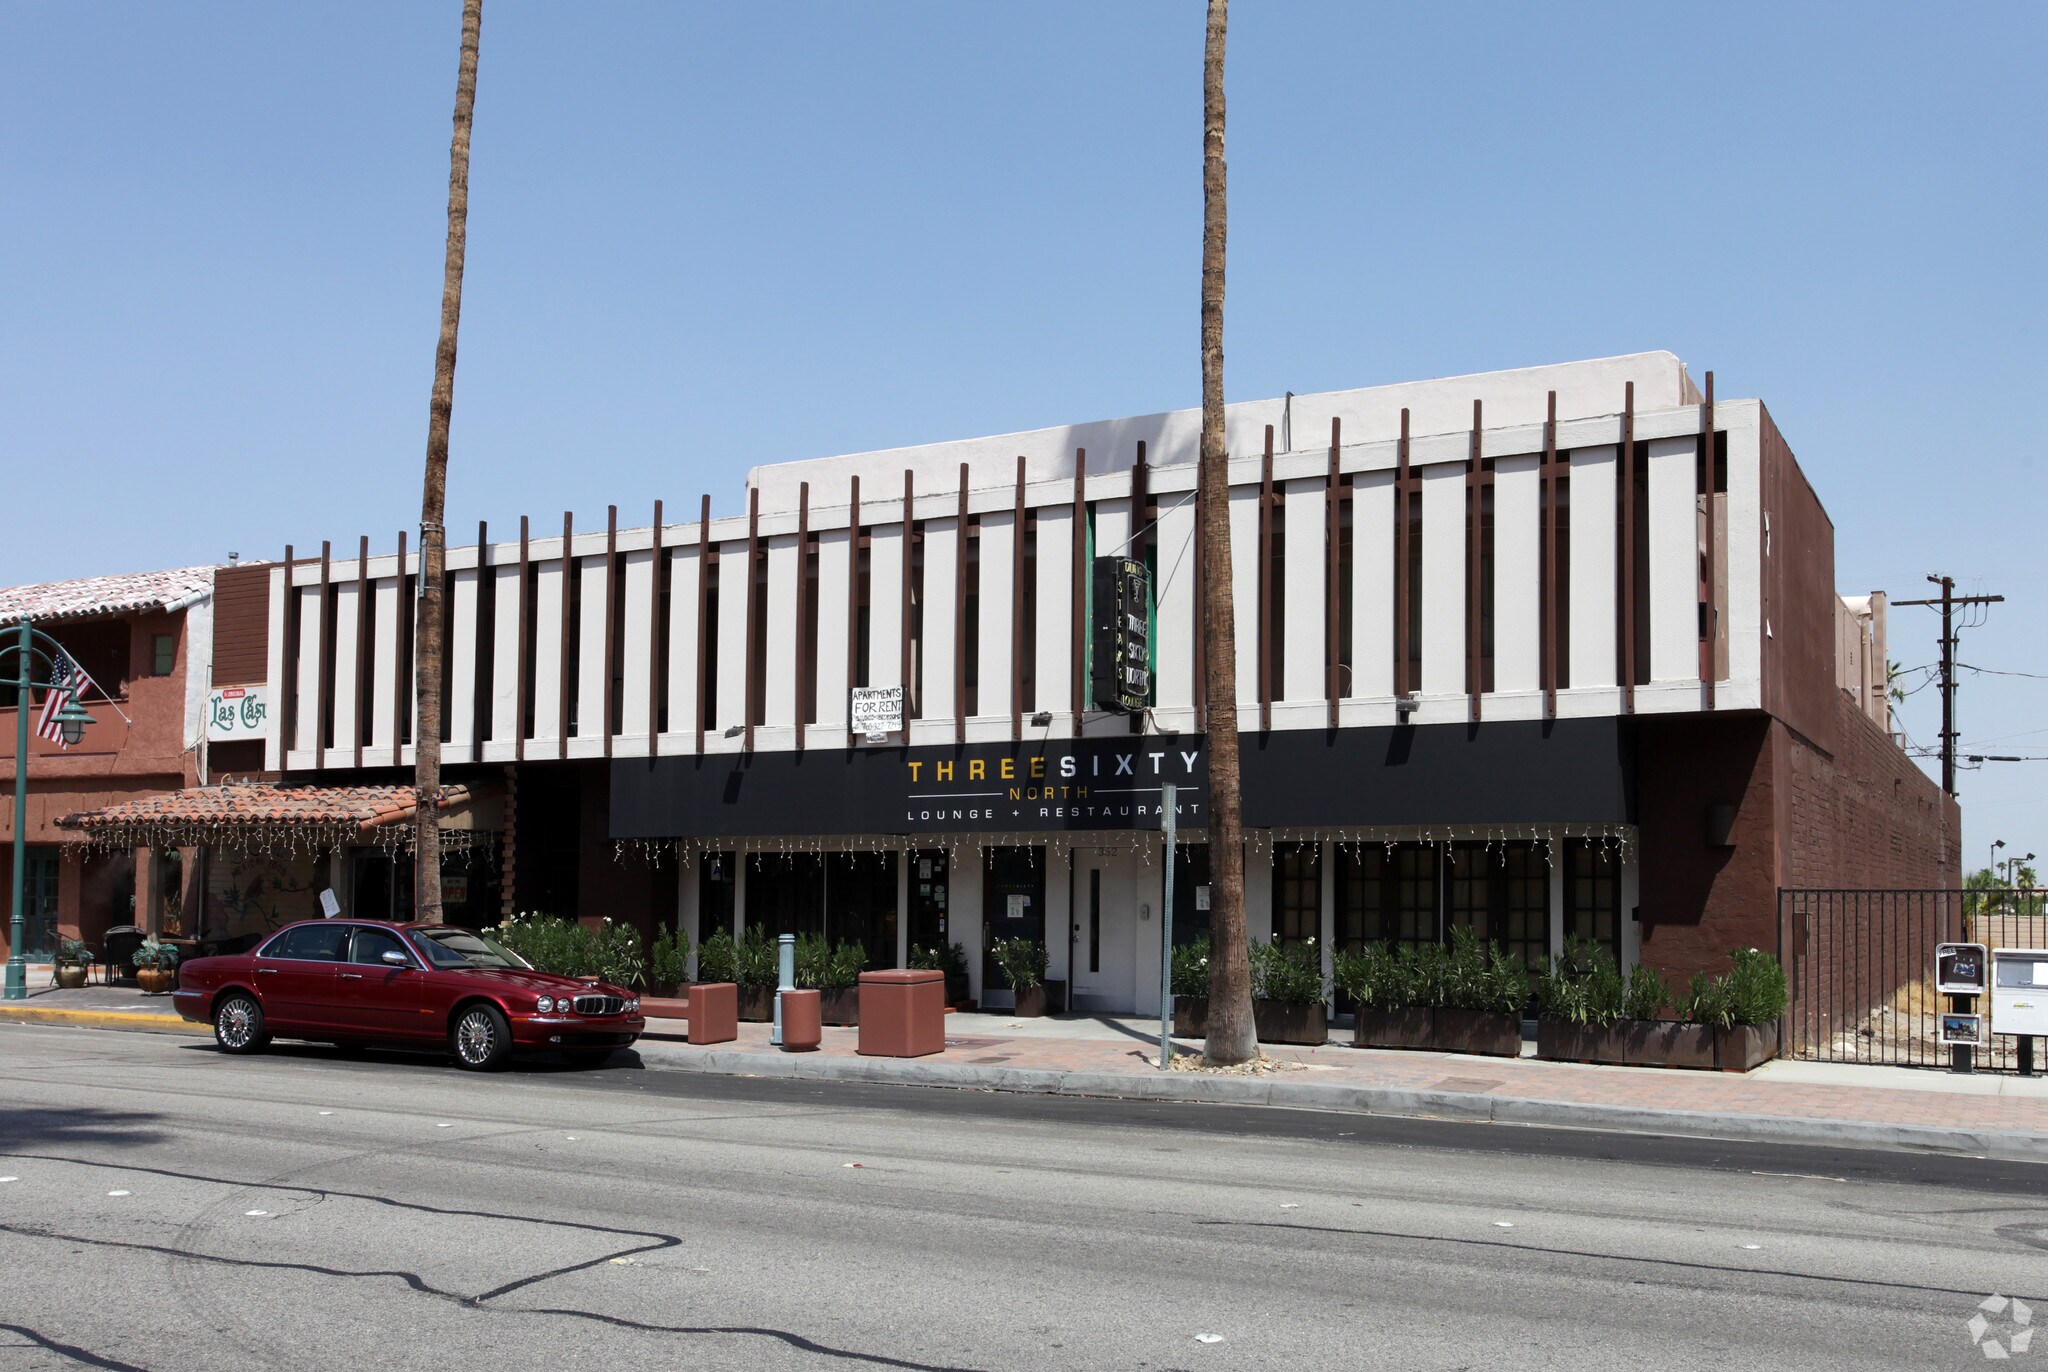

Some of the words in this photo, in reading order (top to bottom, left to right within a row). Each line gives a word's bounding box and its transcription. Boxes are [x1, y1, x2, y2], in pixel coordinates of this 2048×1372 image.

[853, 688, 902, 701] APARTMENTS
[210, 696, 235, 731] Las
[855, 702, 877, 714] FOR
[879, 700, 903, 713] RENT
[1009, 786, 1088, 800] NORTH
[907, 808, 993, 821] LOUNGE
[1040, 804, 1199, 818] RESTAURANT
